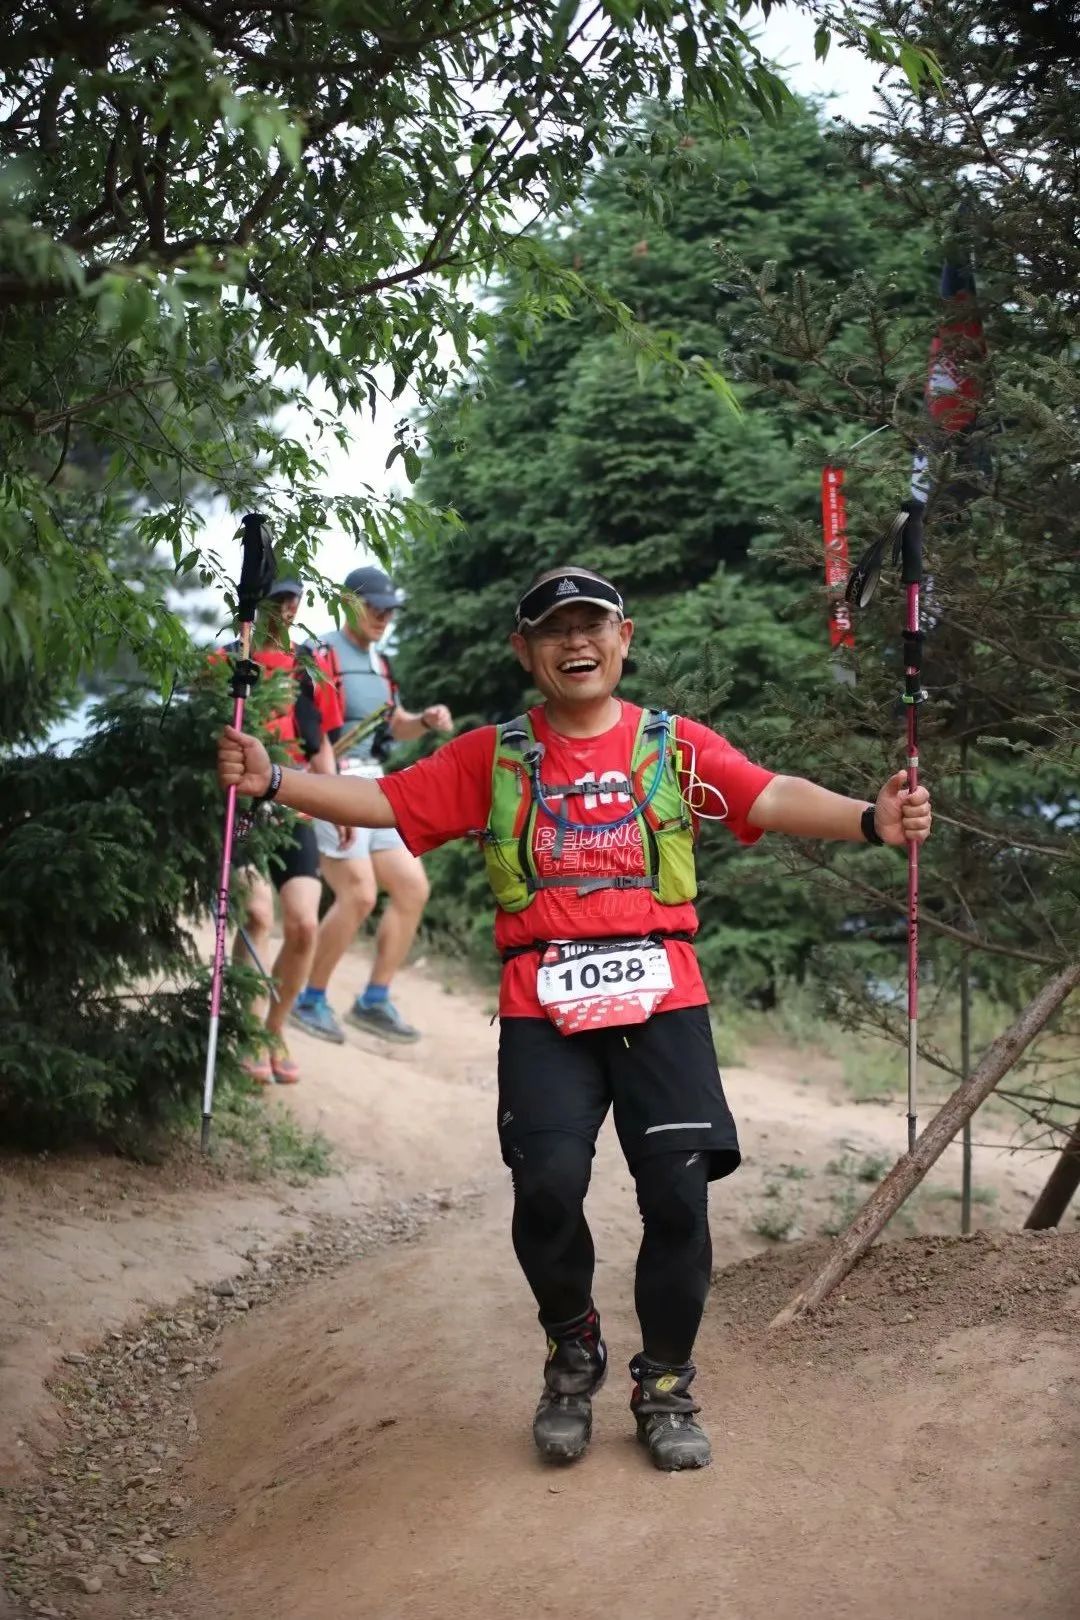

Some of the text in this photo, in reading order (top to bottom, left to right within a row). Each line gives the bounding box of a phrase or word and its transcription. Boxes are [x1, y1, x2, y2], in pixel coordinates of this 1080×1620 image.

[534, 822, 643, 851] BEIJING
[538, 847, 645, 872] BEIJING
[558, 957, 646, 992] 1038
